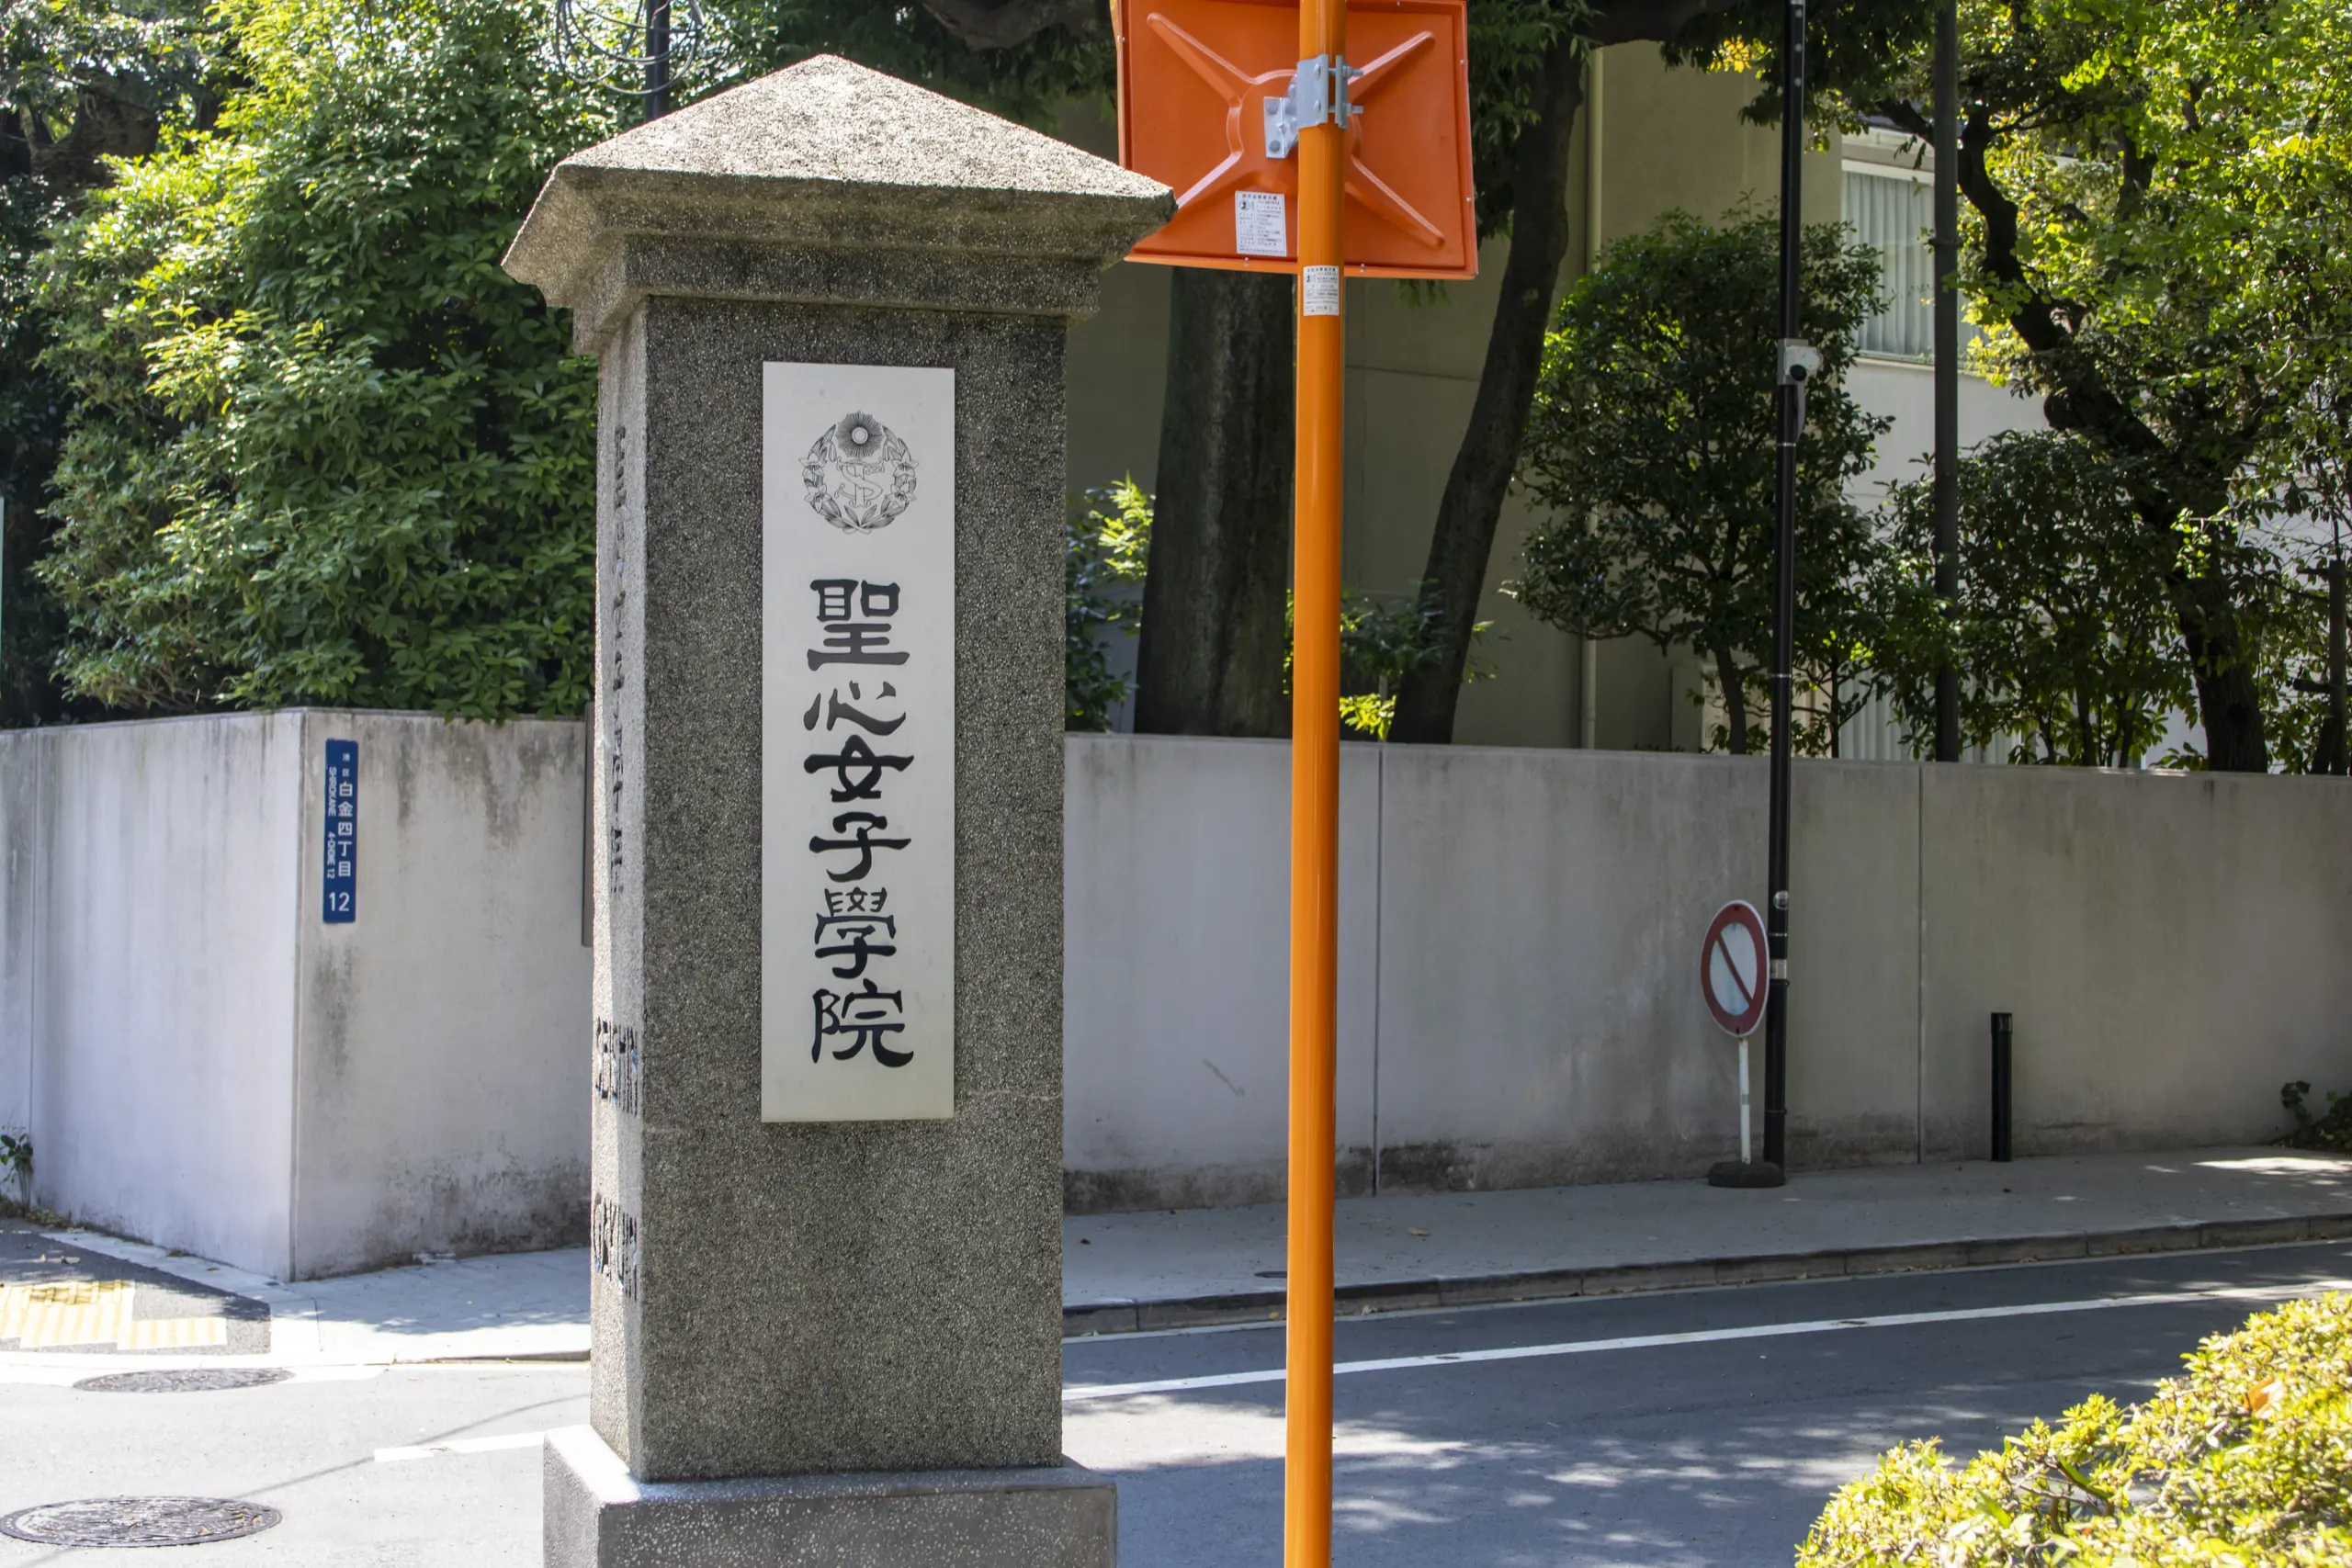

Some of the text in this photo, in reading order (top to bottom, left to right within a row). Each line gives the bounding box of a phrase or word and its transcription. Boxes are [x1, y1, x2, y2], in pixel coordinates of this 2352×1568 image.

[328, 766, 336, 817] SHIROKANE
[338, 781, 353, 876] 白金四丁目
[803, 579, 915, 1068] 聖心女子學院
[327, 869, 335, 878] 12
[329, 891, 350, 911] 12
